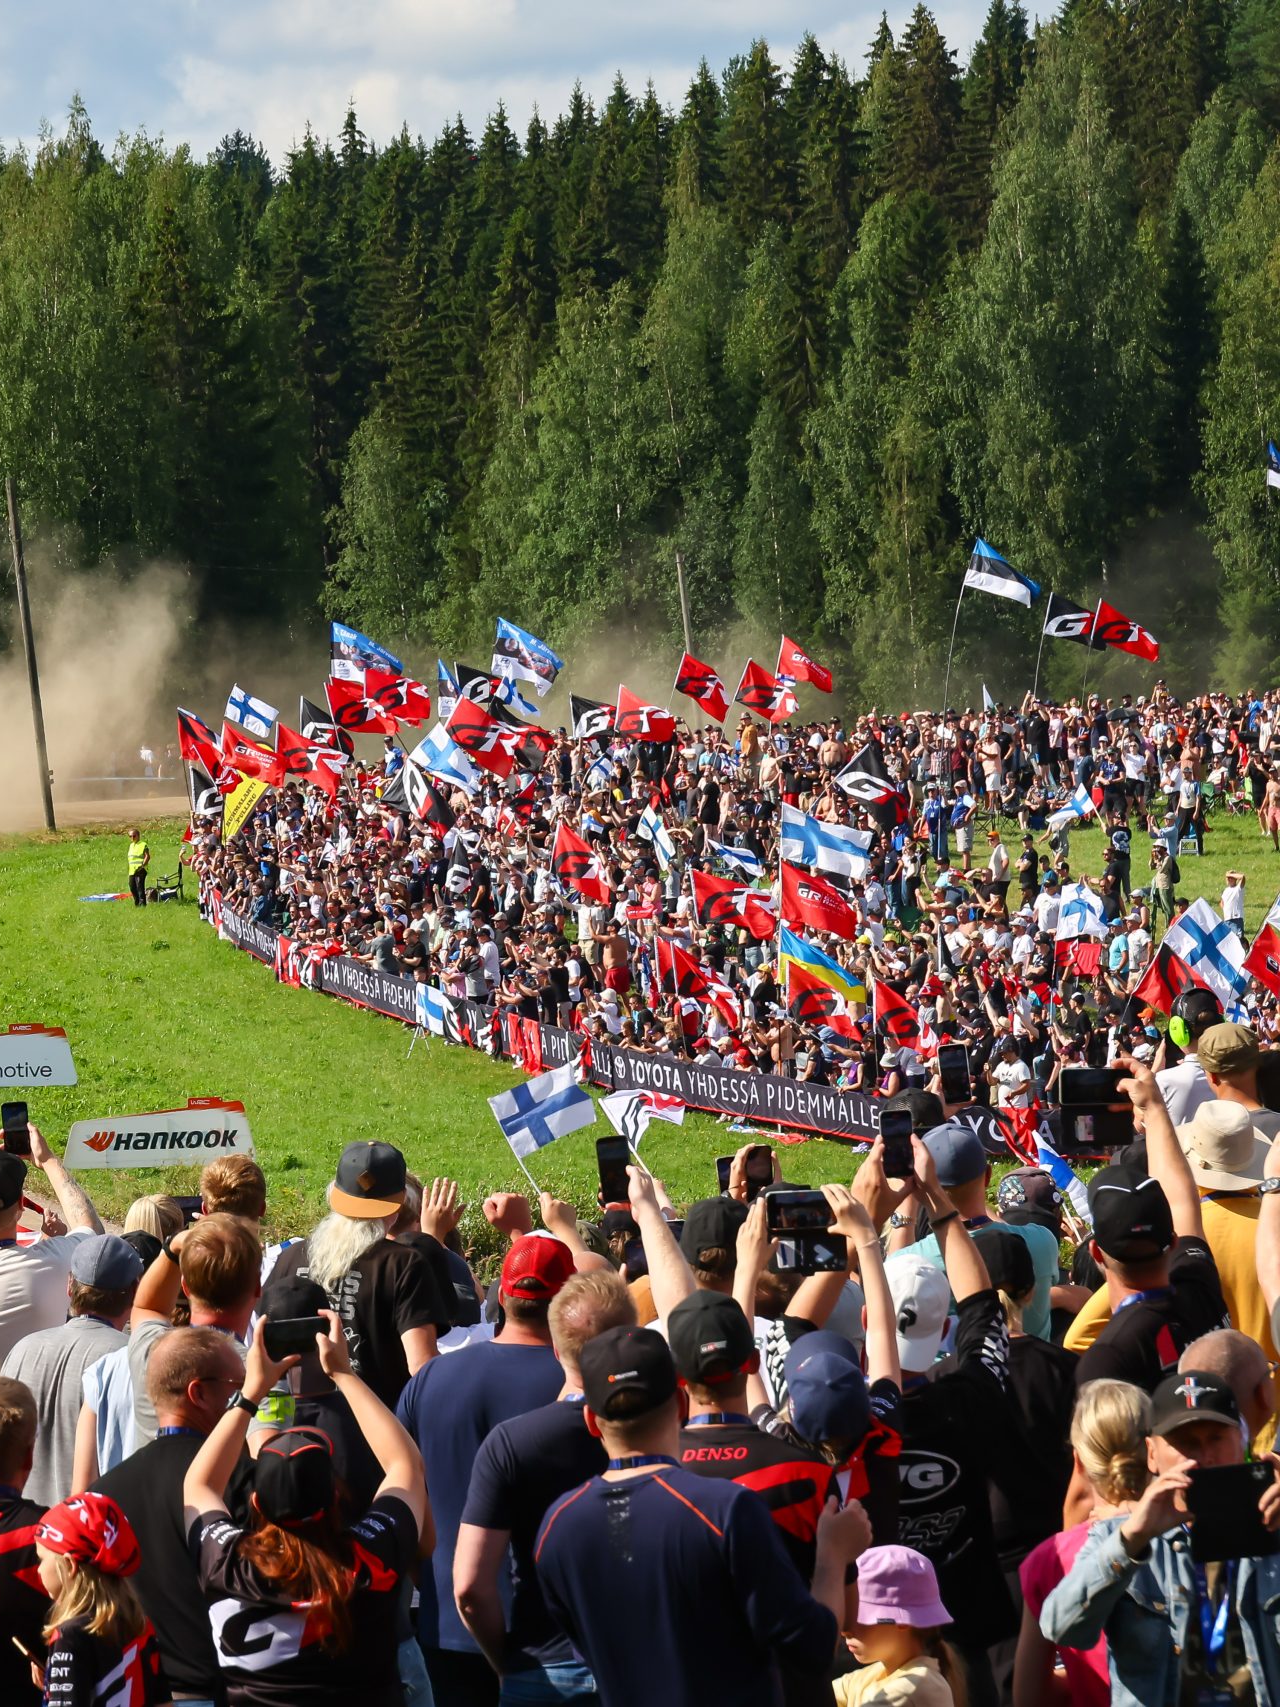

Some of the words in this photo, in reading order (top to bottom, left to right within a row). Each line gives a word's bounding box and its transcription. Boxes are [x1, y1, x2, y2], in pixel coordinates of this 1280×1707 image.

[629, 1058, 682, 1092] TOYOTA
[687, 1069, 760, 1106] YHDESSÄ
[767, 1083, 880, 1131] PIDEMMÄLLE
[682, 1446, 749, 1463] DENSO
